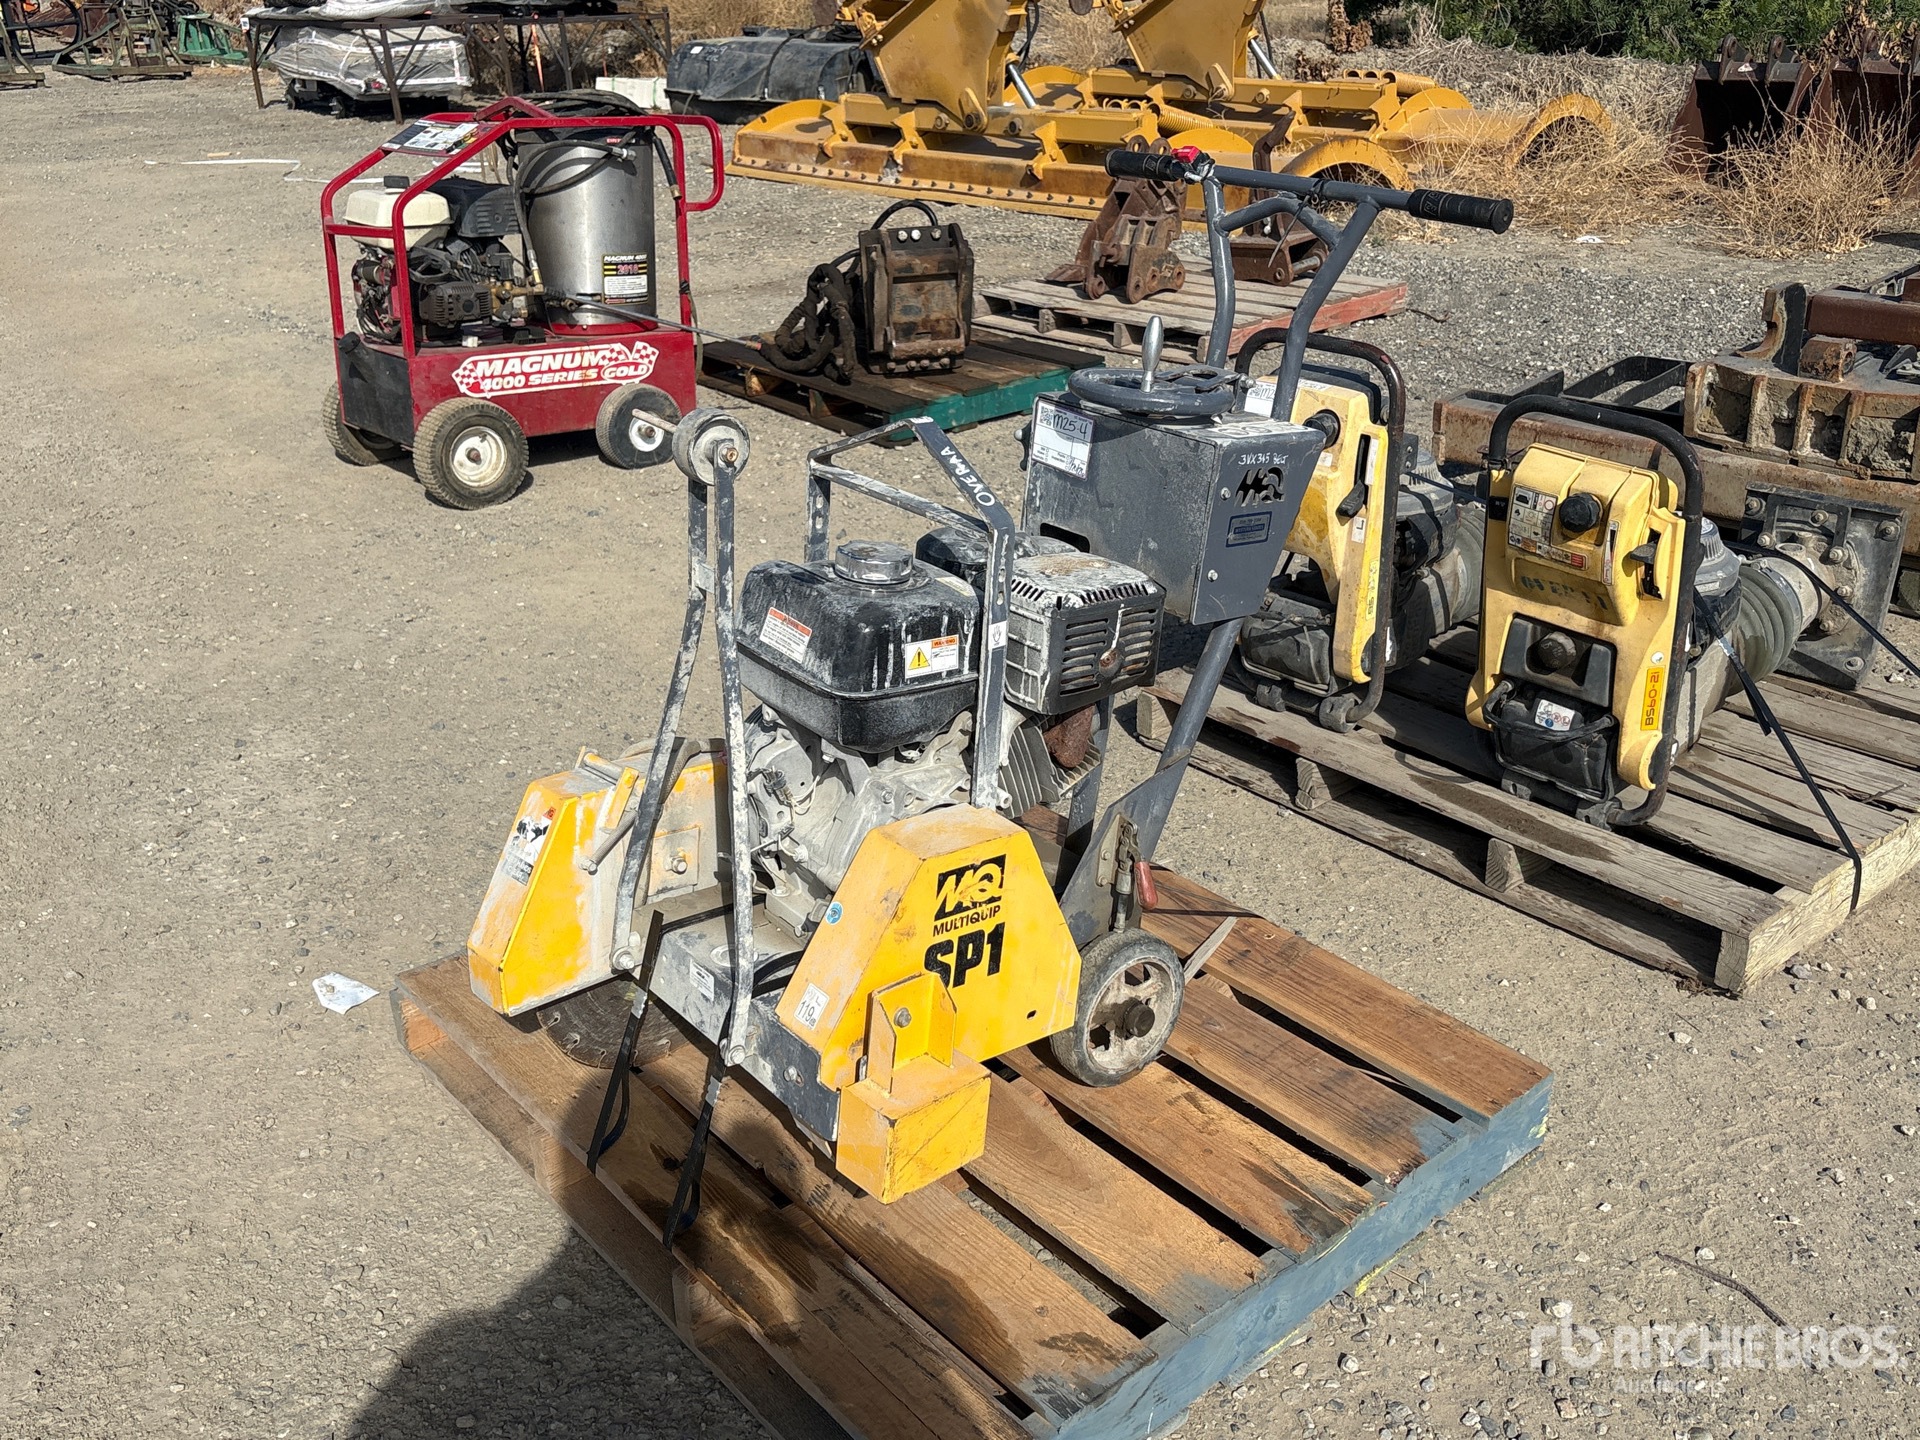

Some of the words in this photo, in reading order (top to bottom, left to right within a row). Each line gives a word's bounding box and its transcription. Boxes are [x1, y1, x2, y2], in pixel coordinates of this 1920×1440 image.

[475, 350, 602, 377] MAGNUM
[480, 375, 525, 391] 4000
[528, 368, 598, 386] SERIES
[603, 365, 646, 379] GOLD
[933, 859, 1005, 919] MQ
[933, 904, 1001, 937] MULTIQUIP
[924, 921, 1006, 989] SP1
